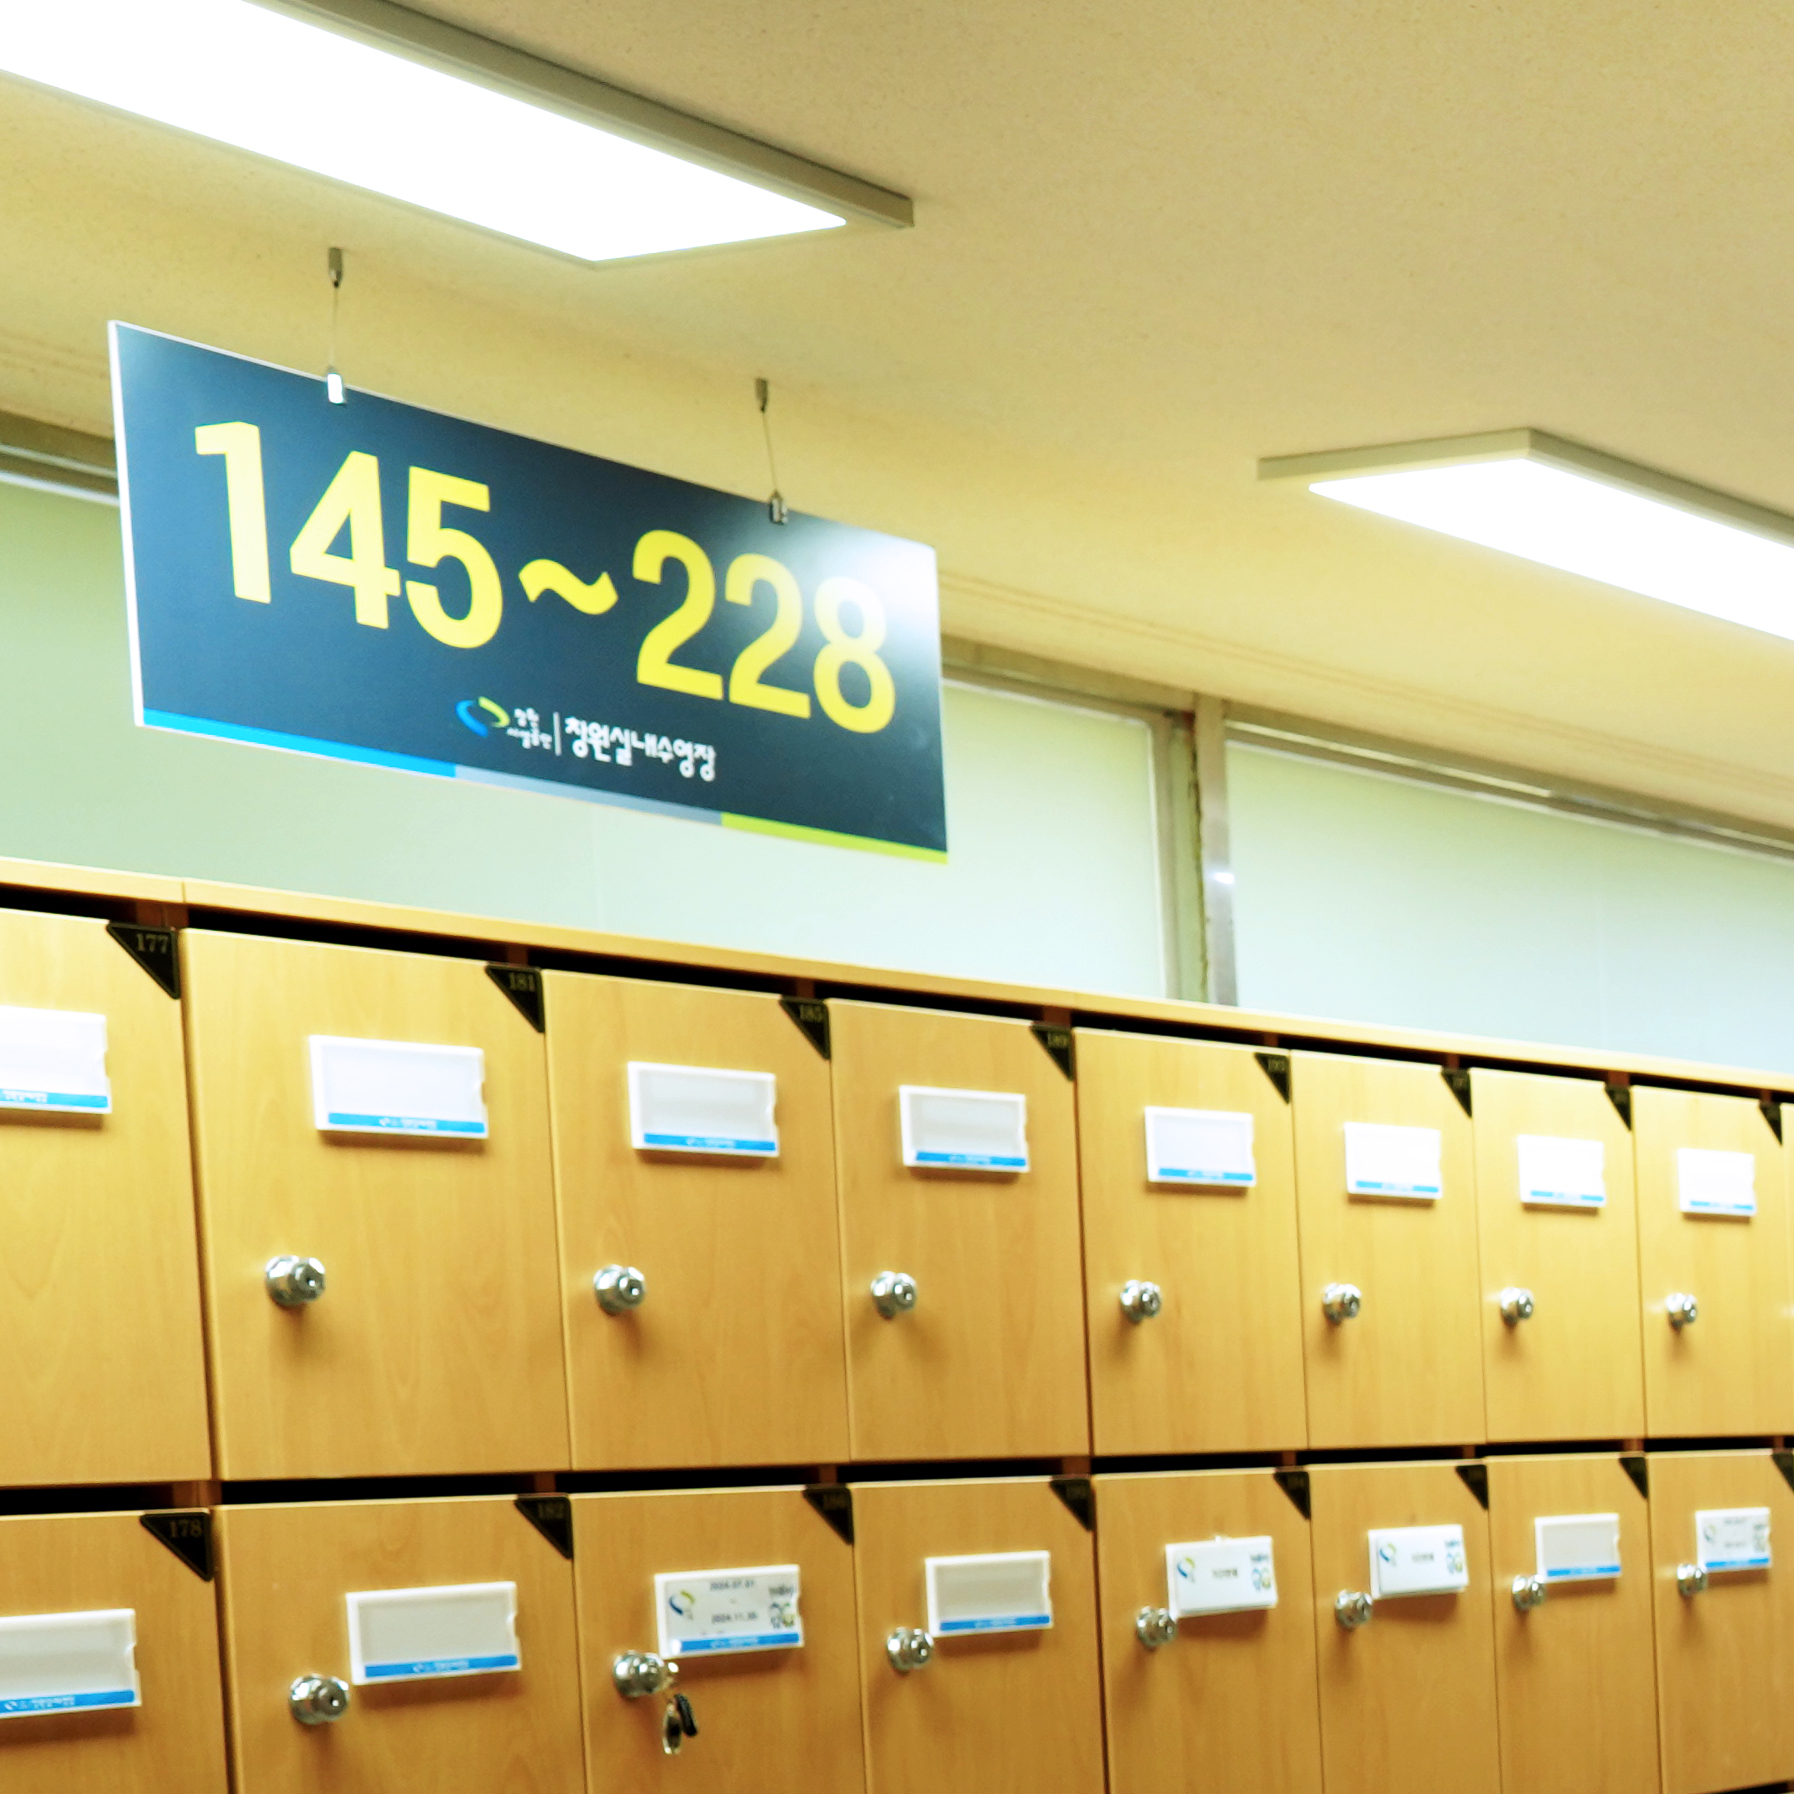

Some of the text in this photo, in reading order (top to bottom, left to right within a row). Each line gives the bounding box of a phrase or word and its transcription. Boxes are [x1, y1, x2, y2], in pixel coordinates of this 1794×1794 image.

[195, 421, 895, 734] 145~228
[564, 716, 717, 782] 창원실내수영장
[136, 933, 169, 955] 177
[509, 972, 536, 993] 181
[170, 1519, 203, 1539] 178
